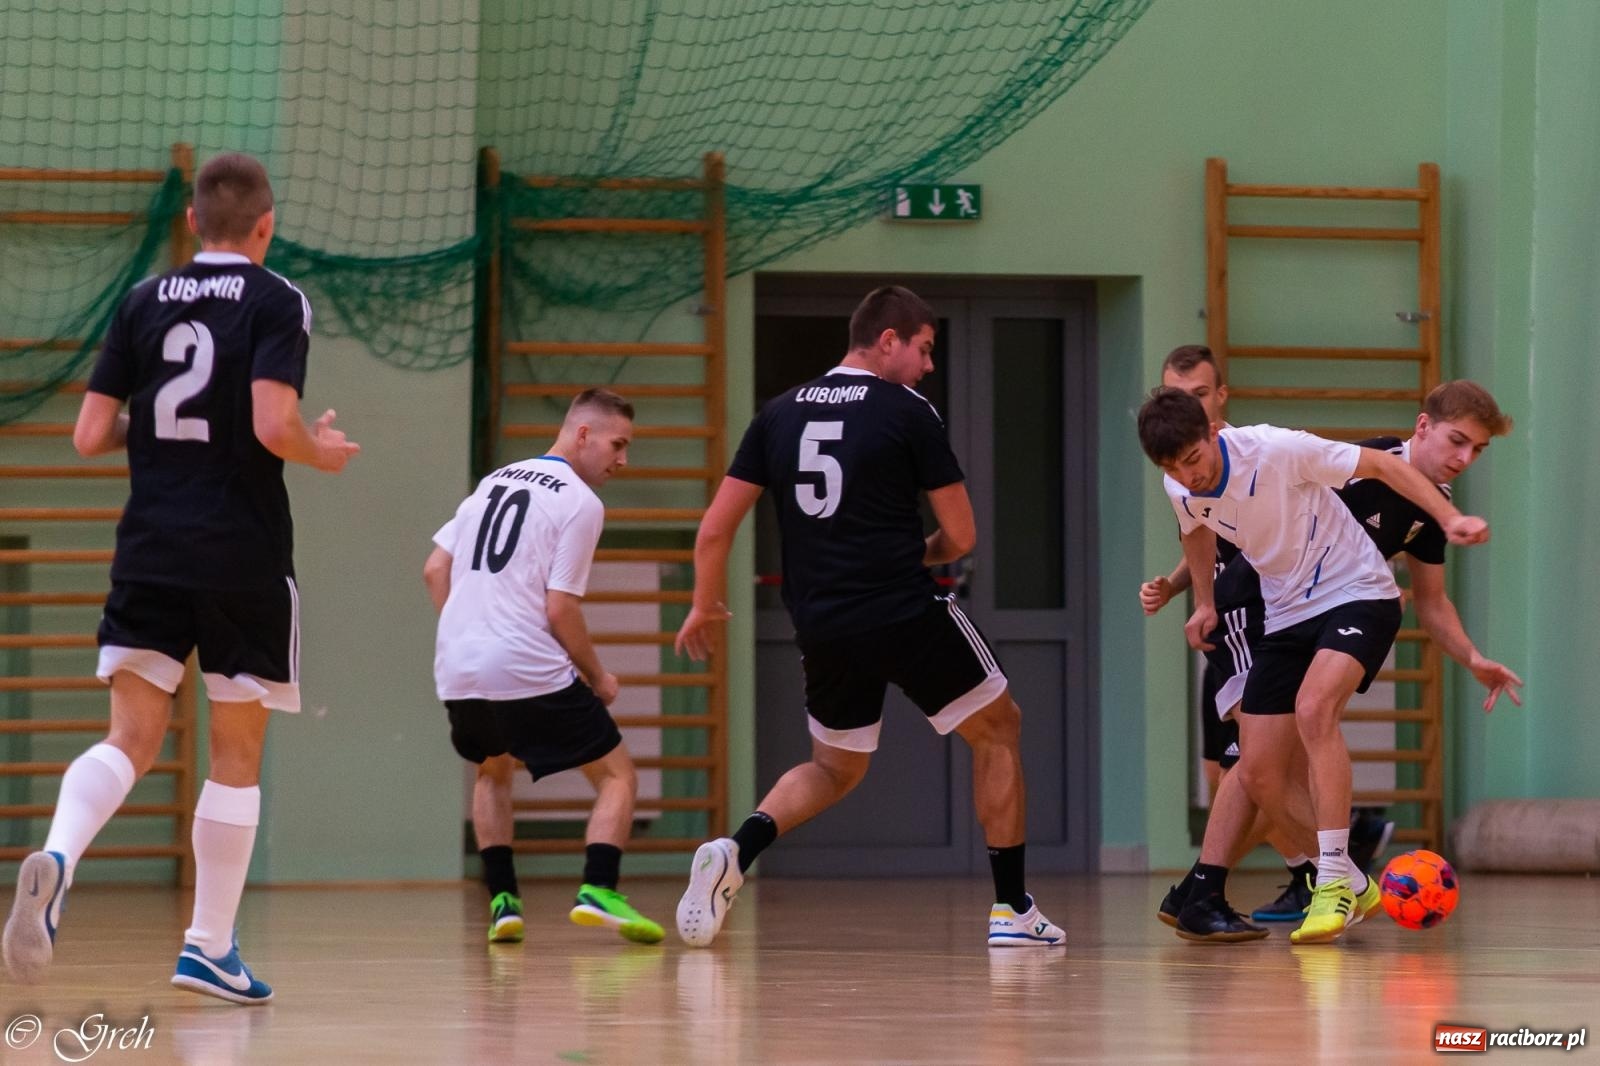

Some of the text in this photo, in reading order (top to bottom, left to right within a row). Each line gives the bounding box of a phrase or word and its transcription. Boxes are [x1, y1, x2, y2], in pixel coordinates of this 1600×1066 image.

[153, 319, 215, 442] 2
[795, 385, 869, 404] LUBOMIA
[795, 420, 844, 519] 5
[471, 484, 531, 574] 10
